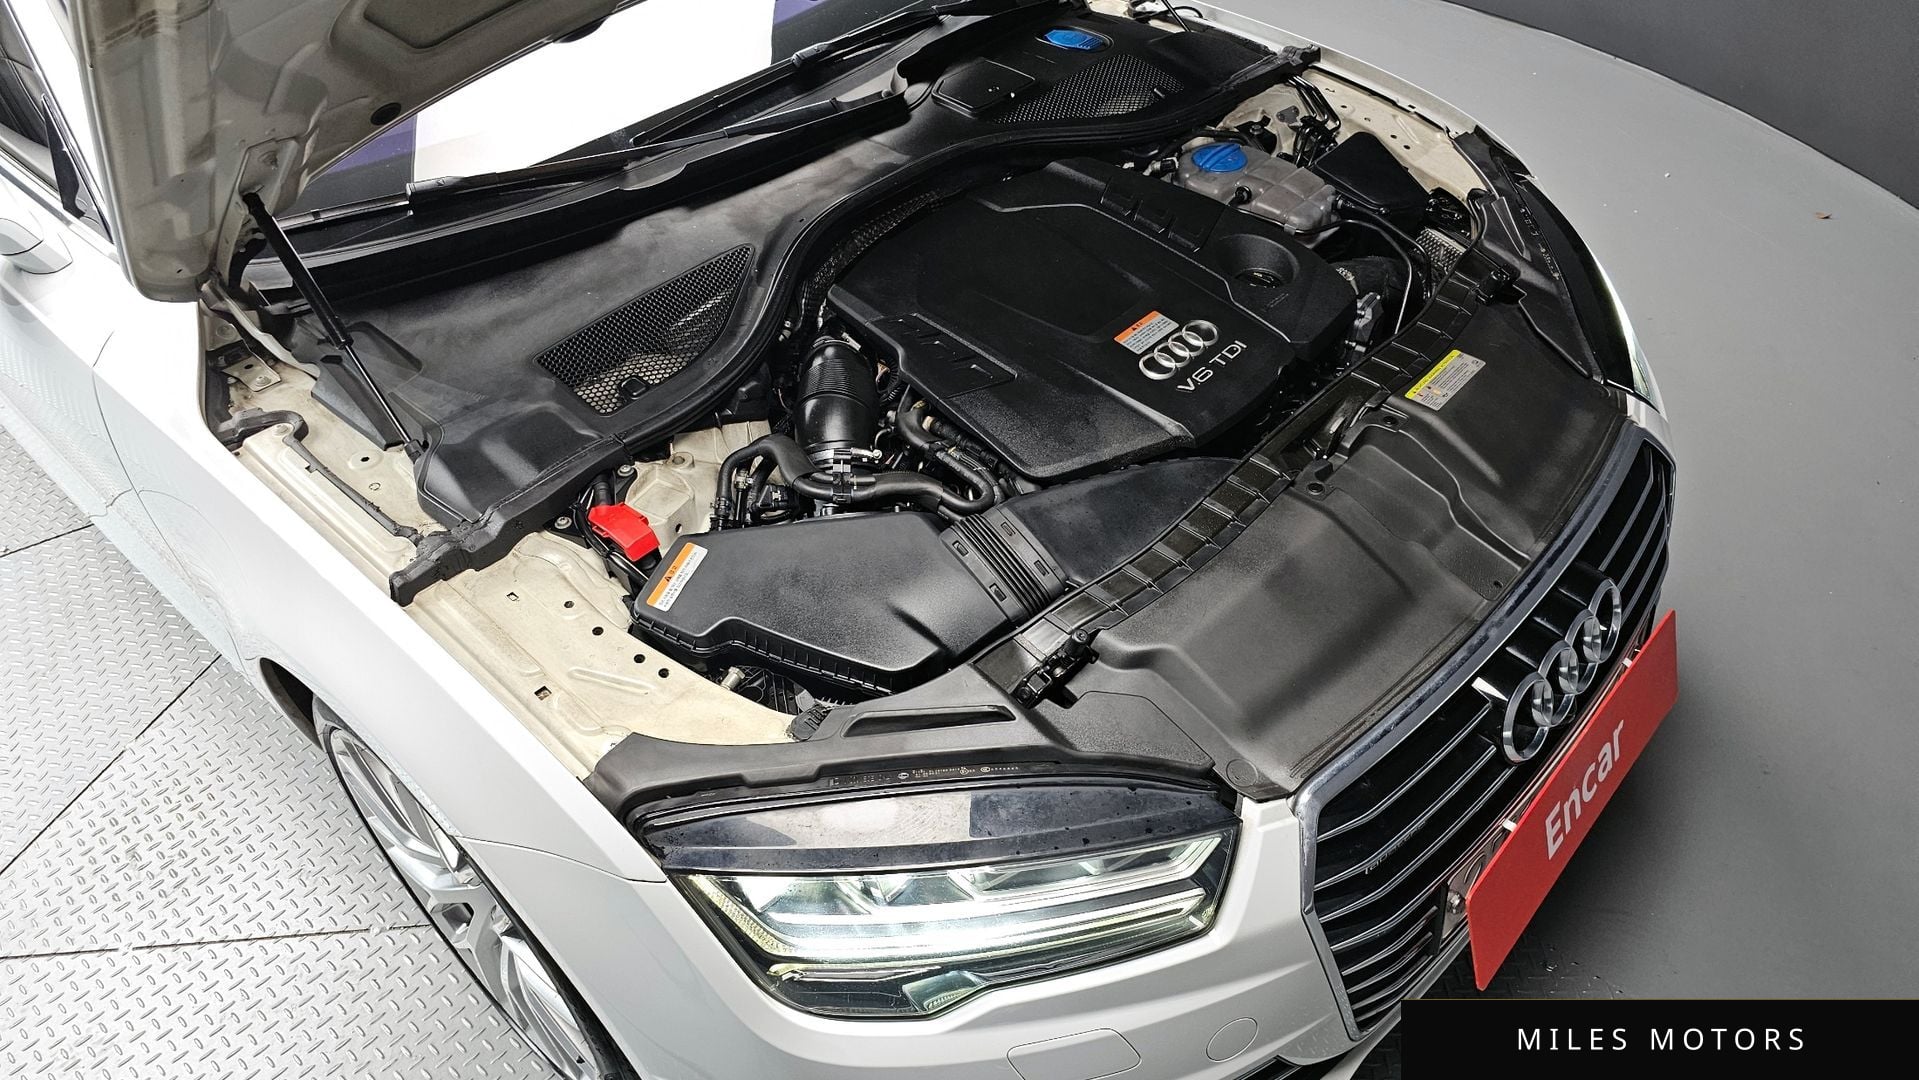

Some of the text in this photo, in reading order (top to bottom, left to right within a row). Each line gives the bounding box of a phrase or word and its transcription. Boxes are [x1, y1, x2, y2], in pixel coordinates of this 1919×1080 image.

[1176, 340, 1247, 392] V6 TDI
[1544, 719, 1624, 860] Encar
